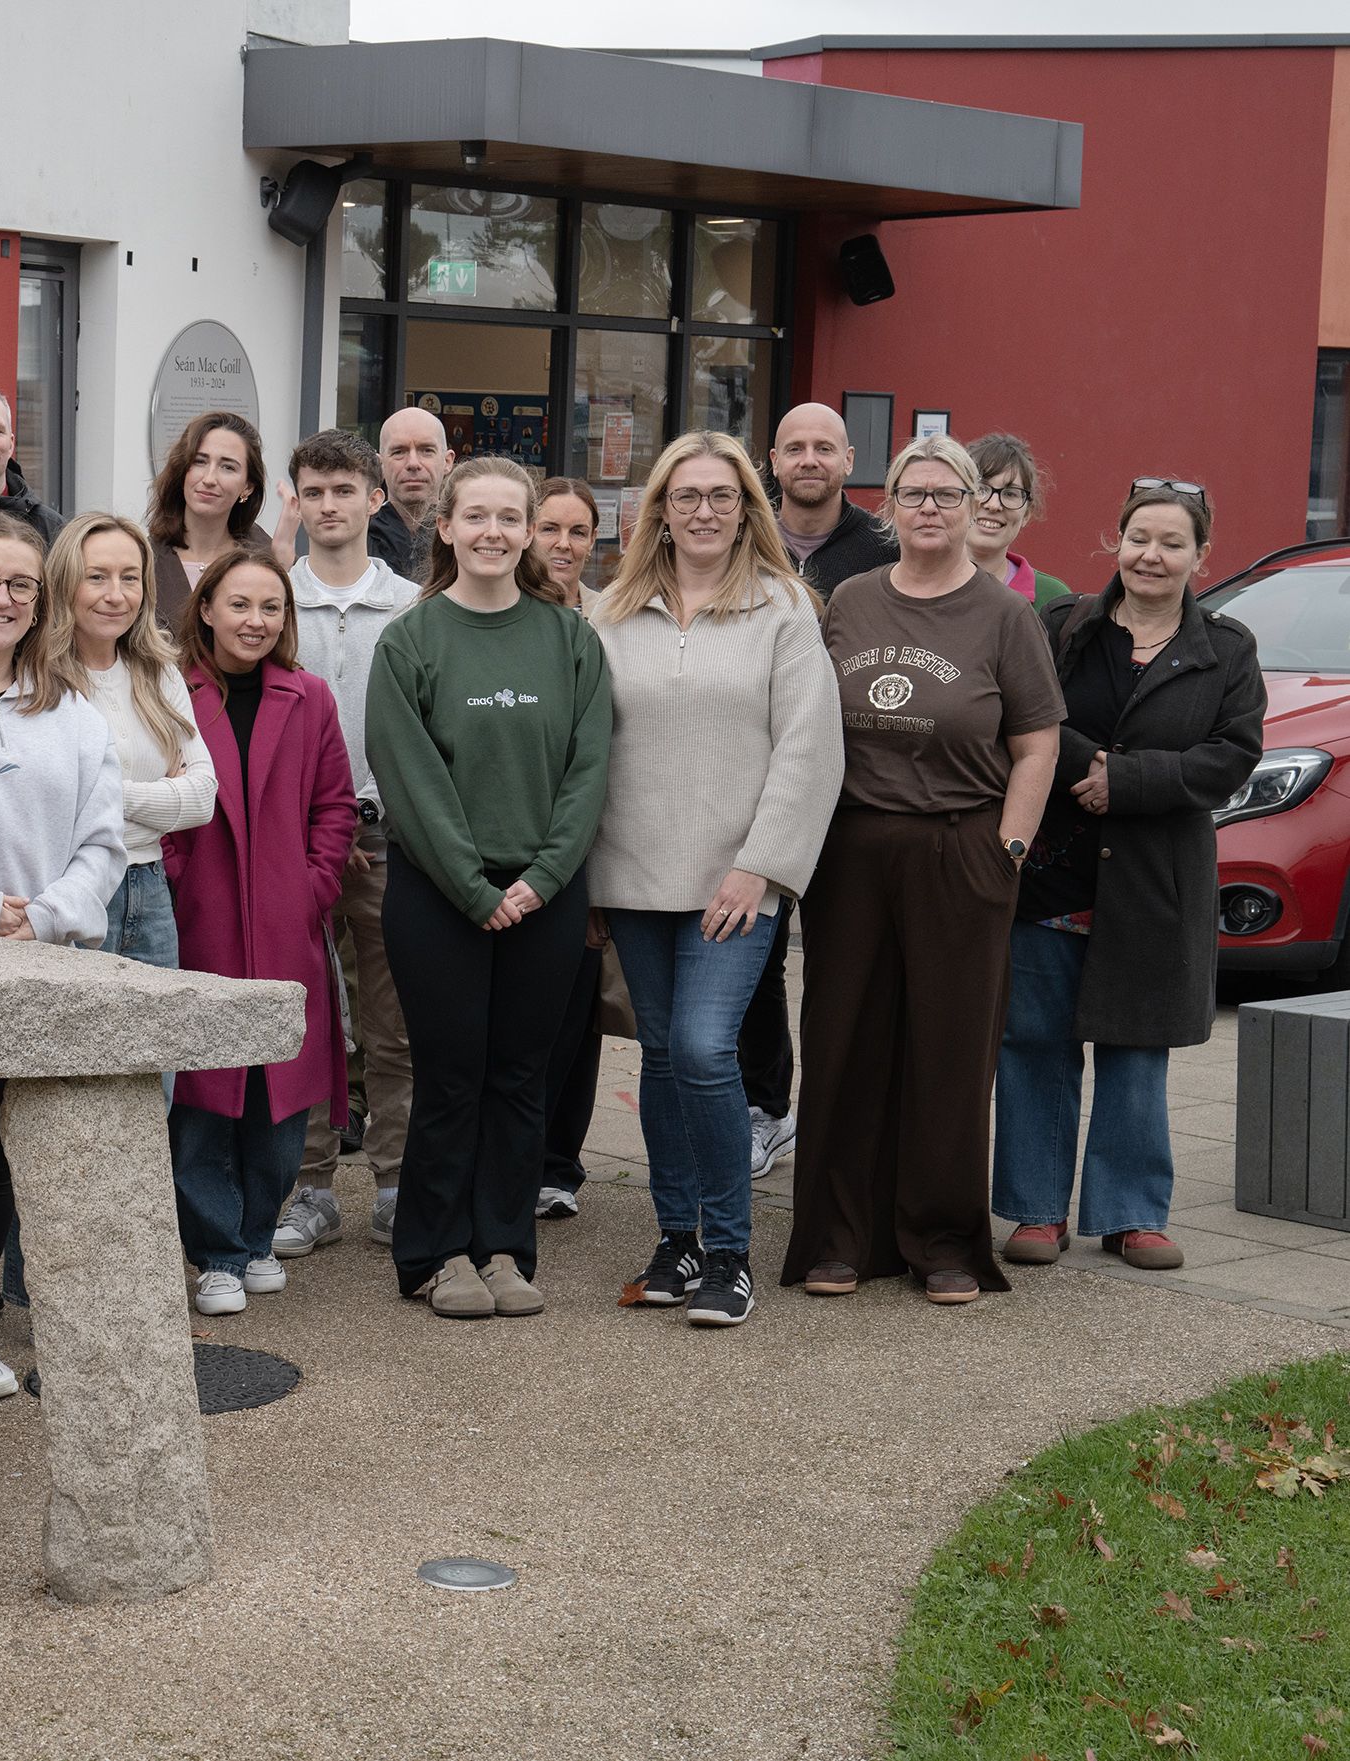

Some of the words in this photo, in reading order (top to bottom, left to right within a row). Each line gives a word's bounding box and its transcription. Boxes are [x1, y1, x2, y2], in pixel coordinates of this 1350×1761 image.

[174, 355, 195, 372] Seán
[197, 357, 218, 373] Mac
[219, 357, 241, 374] Goill
[840, 648, 880, 676] RICH
[884, 645, 896, 663] &
[898, 646, 961, 684] RESTED
[843, 712, 874, 729] ALM
[877, 714, 935, 734] SPRINGS
